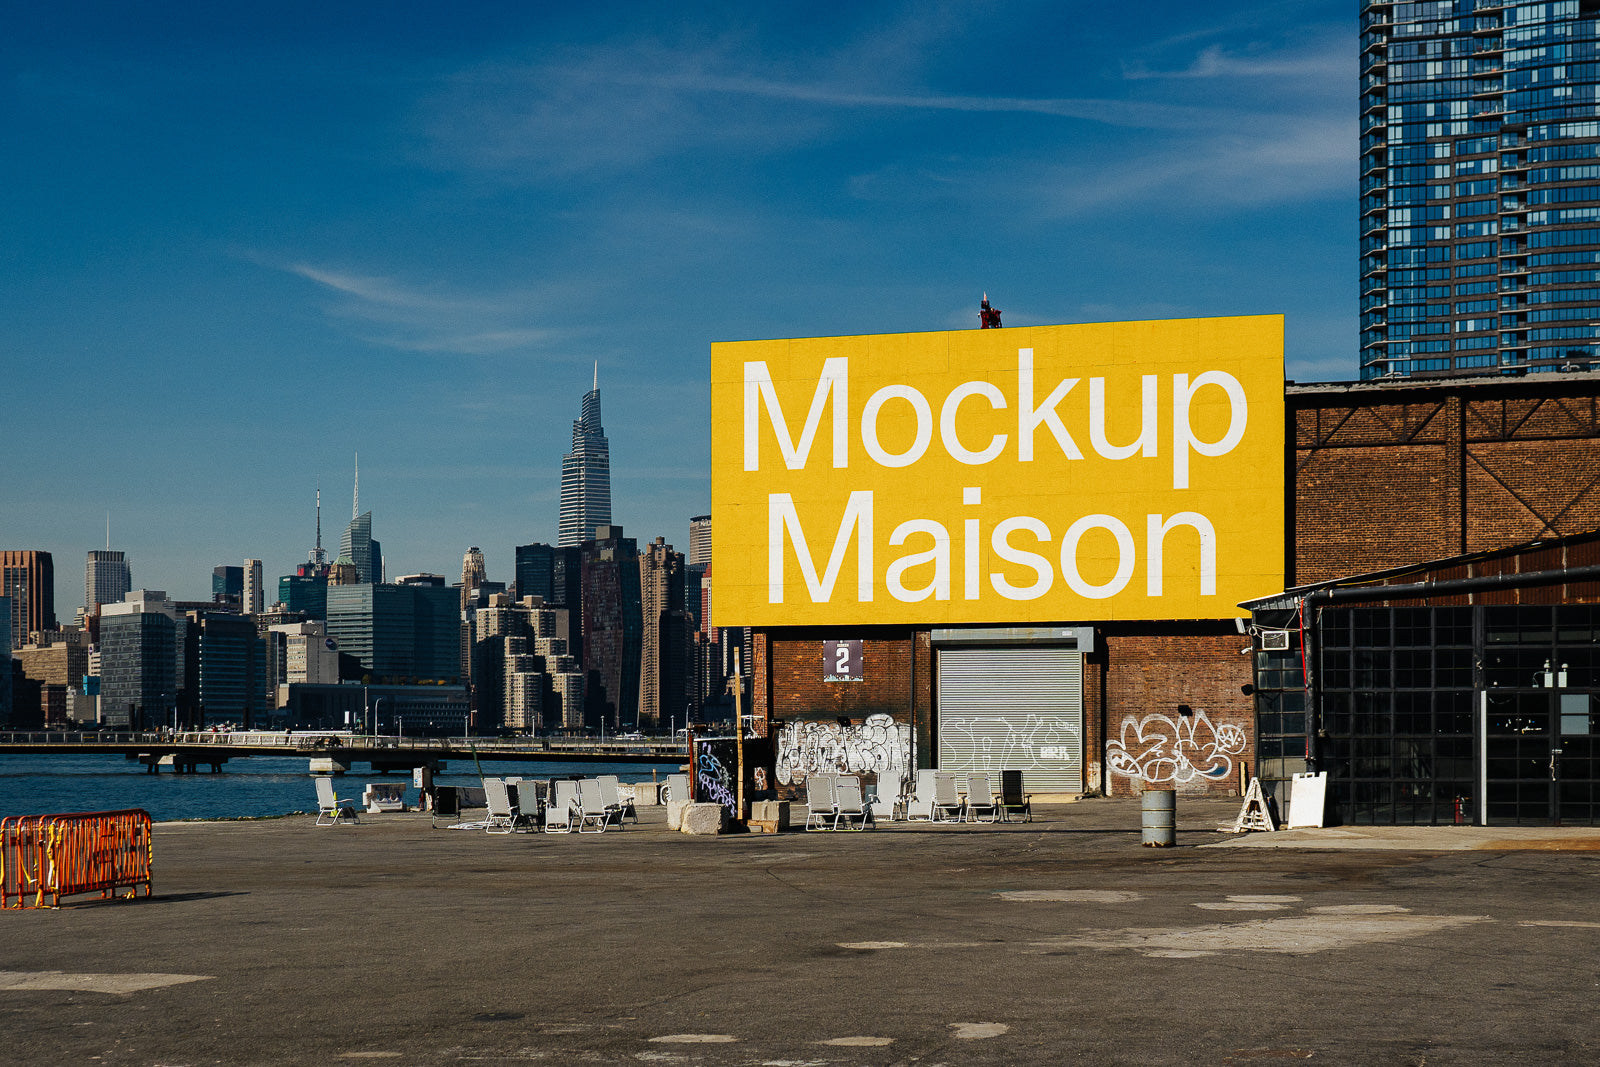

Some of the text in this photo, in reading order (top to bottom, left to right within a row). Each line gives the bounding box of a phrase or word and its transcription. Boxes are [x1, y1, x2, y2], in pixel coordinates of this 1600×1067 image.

[743, 347, 1248, 490] Mockup
[768, 486, 1217, 604] Maison
[836, 647, 850, 674] 2
